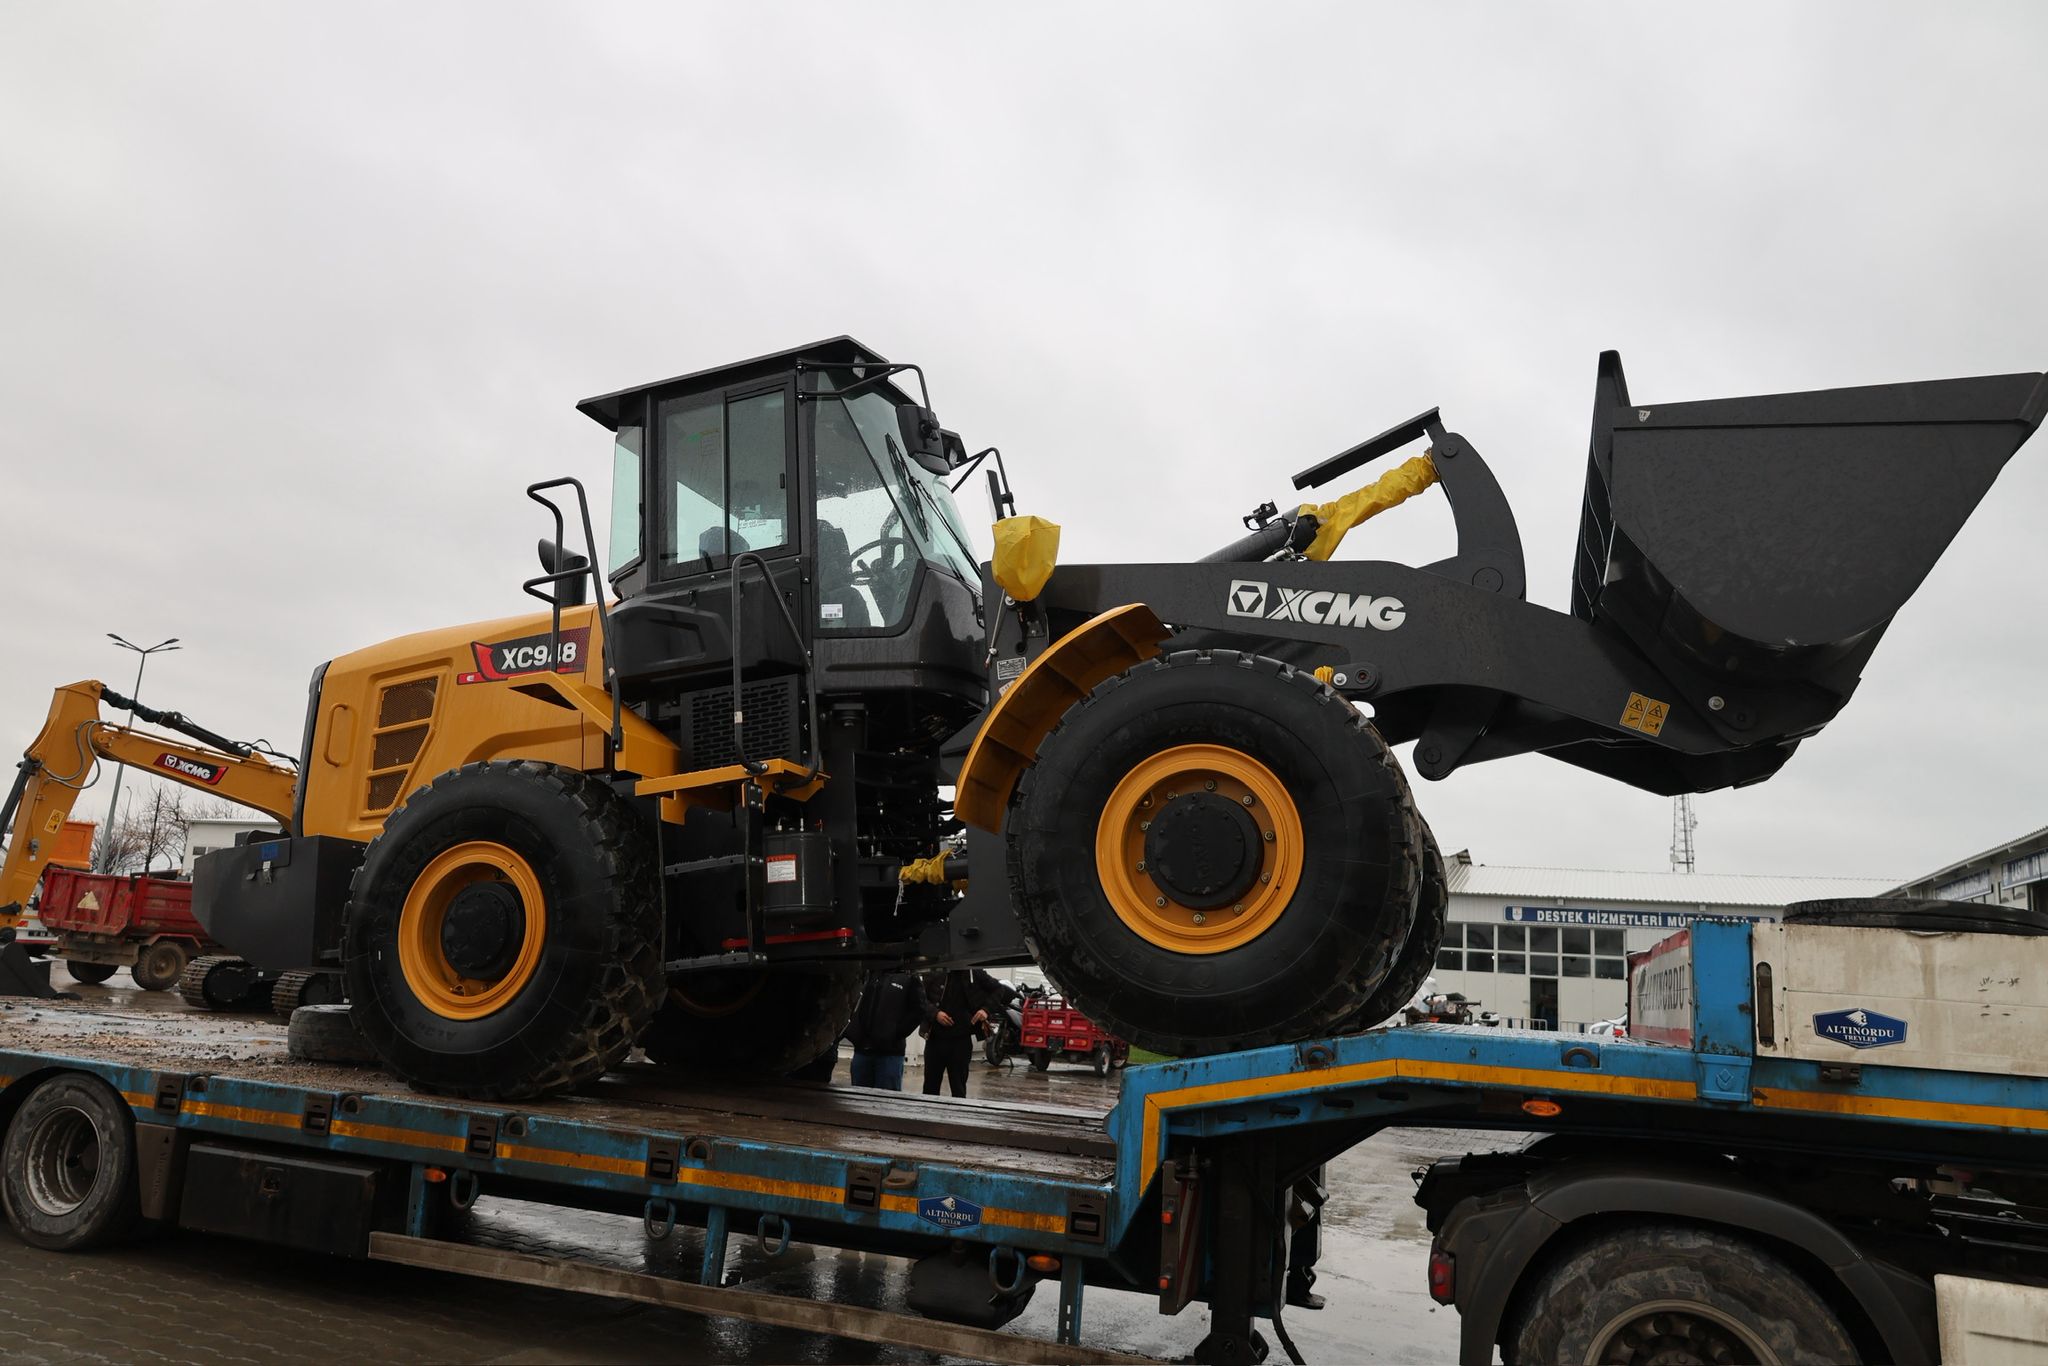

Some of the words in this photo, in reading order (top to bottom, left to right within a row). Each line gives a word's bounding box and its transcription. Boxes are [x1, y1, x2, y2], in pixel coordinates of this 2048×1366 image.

[1265, 587, 1407, 632] XCMG
[175, 760, 211, 780] XCMG
[1536, 910, 1584, 923] DESTEK
[1587, 909, 1663, 927] HİZMETLERİ
[1825, 1024, 1895, 1038] ALTINORDU
[1843, 1034, 1878, 1043] TREYLER
[925, 1209, 974, 1222] ALTINORDU
